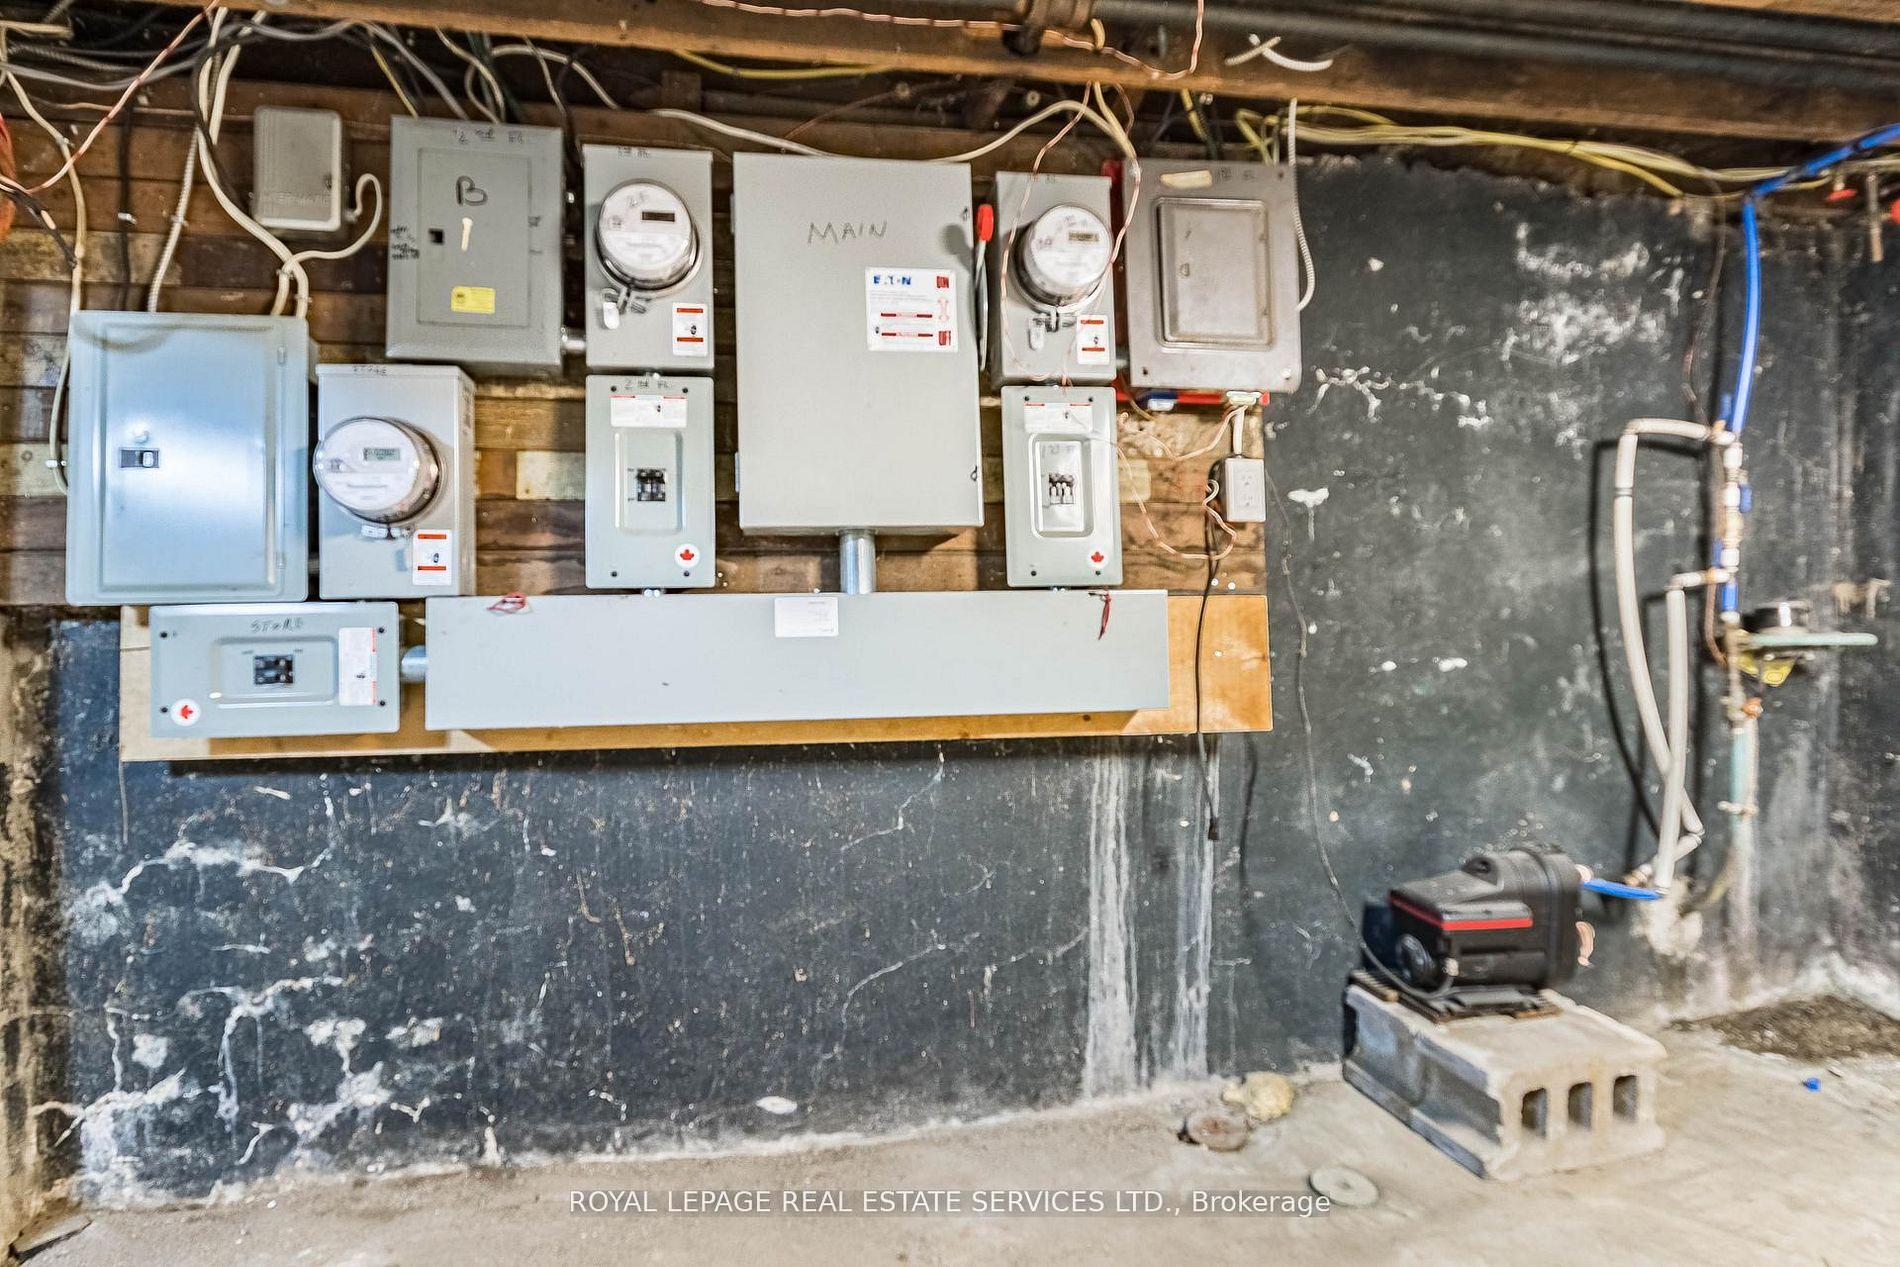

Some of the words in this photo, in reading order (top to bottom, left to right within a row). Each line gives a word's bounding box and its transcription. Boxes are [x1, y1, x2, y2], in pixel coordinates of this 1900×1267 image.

[456, 175, 488, 207] B
[807, 220, 888, 244] MAIN
[873, 275, 912, 286] ETN
